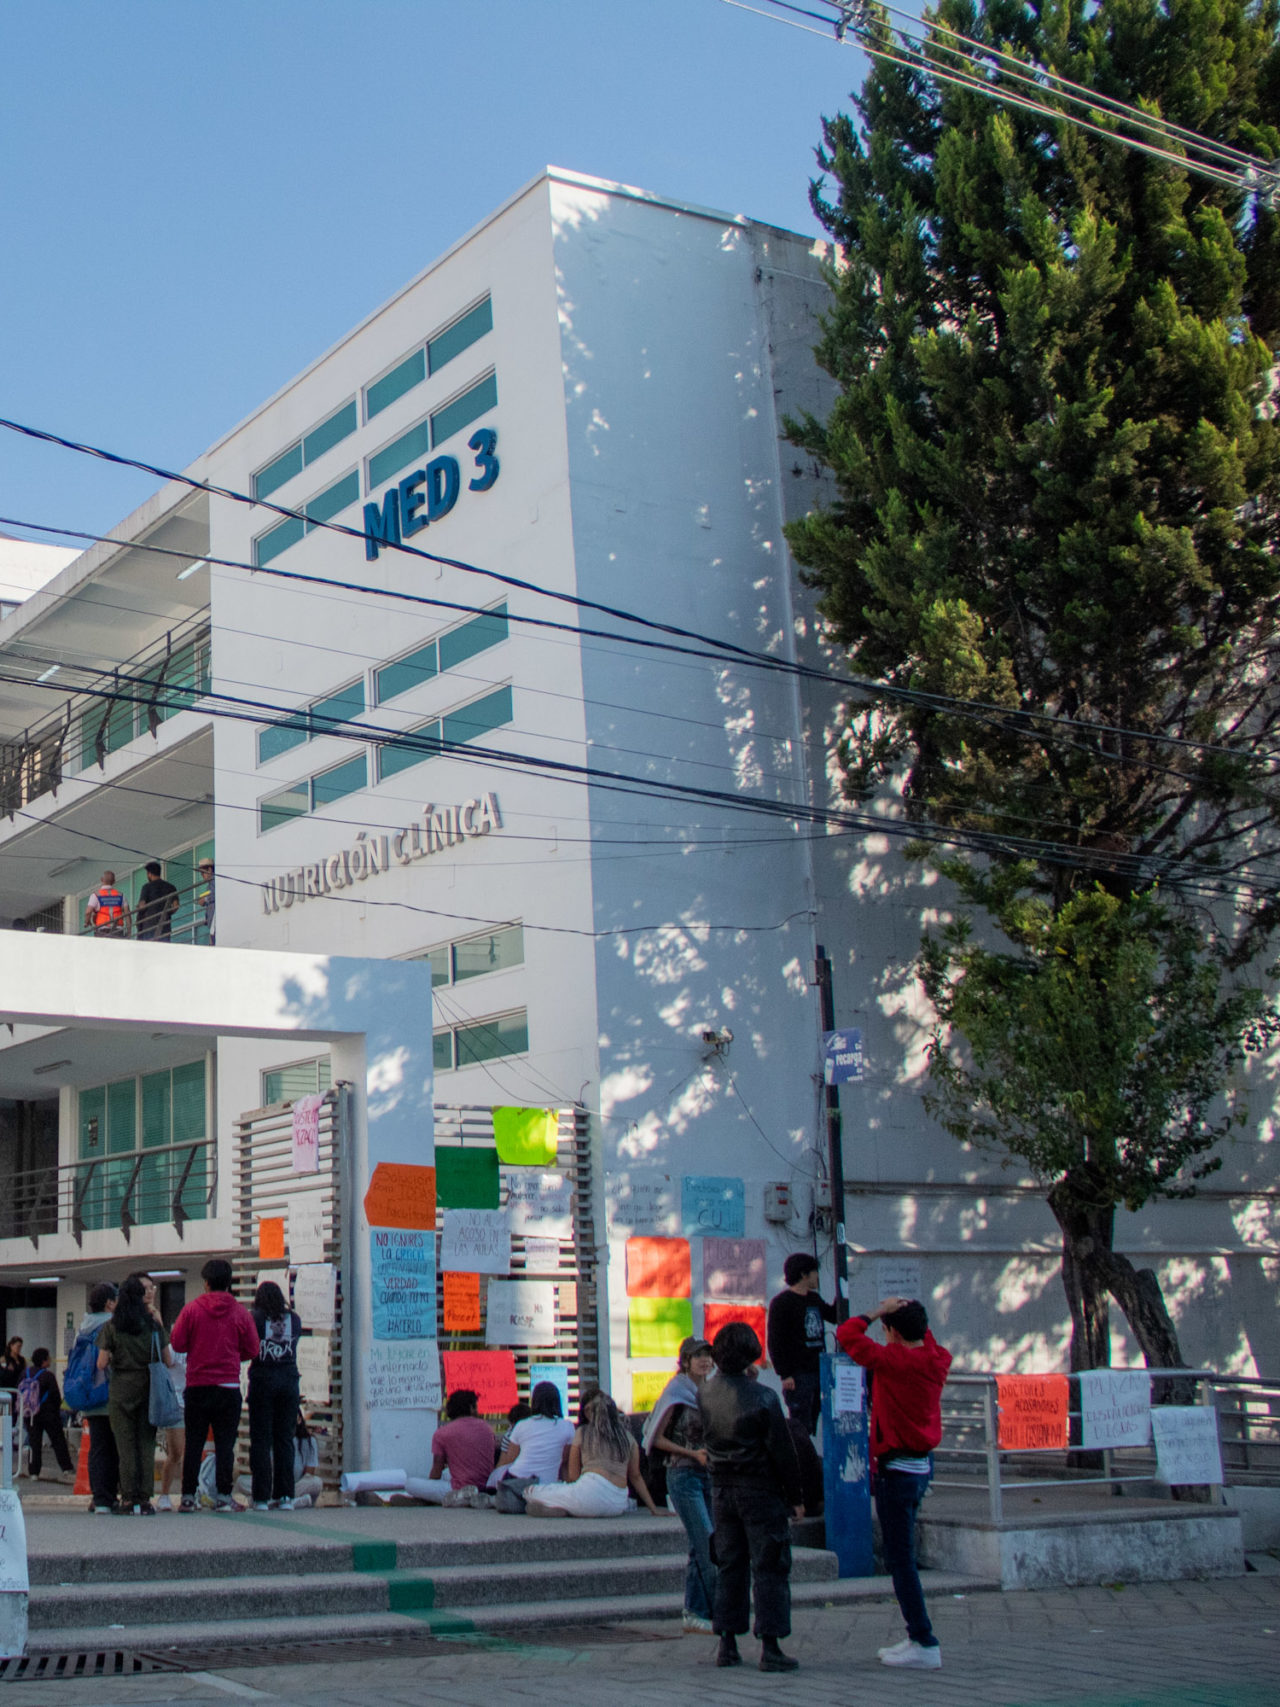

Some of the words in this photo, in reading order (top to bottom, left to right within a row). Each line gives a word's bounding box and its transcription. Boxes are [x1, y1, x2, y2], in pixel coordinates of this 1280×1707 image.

[362, 453, 461, 562] MED
[467, 427, 501, 493] 3
[260, 832, 390, 915] NUTRICIÓN
[391, 792, 504, 866] CLÍNICA
[375, 1232, 389, 1248] NO
[383, 1276, 418, 1290] VERDAD
[387, 1319, 422, 1334] HACERLO
